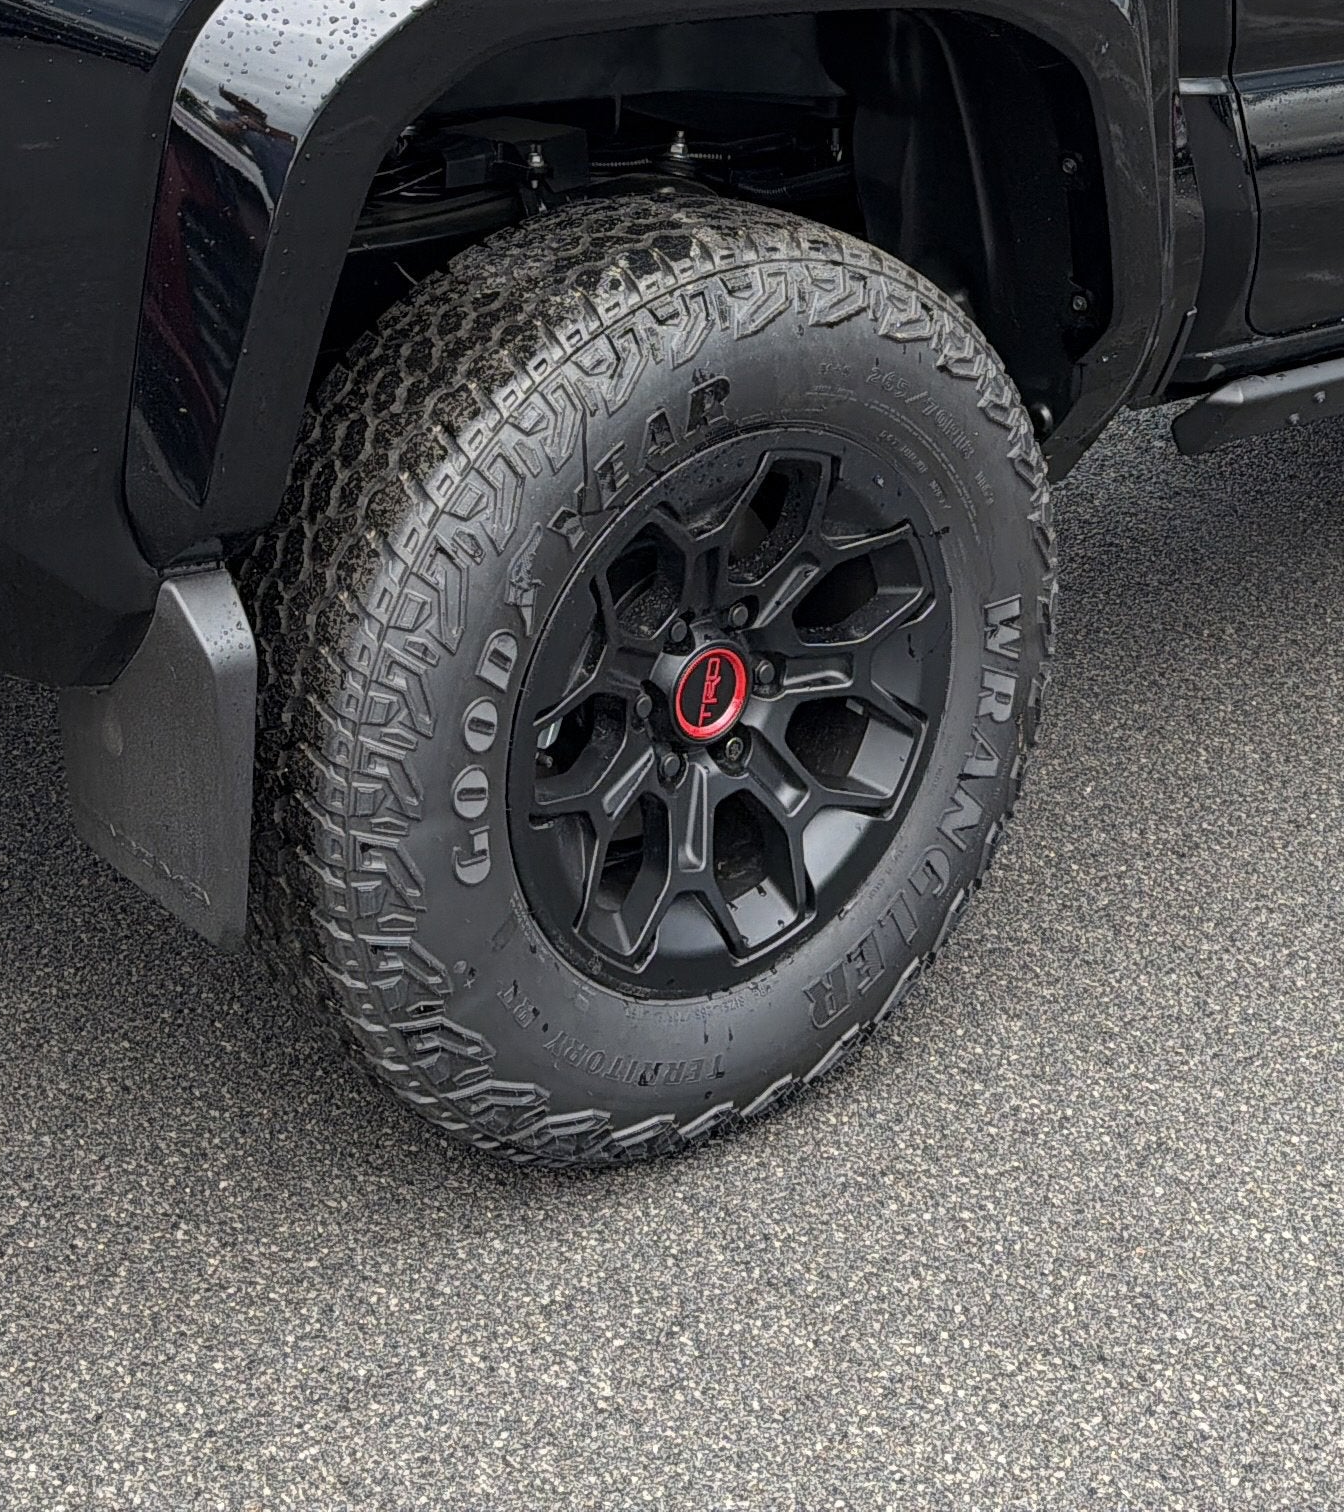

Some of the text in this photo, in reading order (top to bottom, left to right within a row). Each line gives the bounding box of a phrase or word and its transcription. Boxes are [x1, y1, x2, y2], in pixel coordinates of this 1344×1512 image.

[697, 656, 722, 729] TRD
[803, 593, 1023, 1030] WRANGLER
[543, 1029, 727, 1087] TERRITORY
